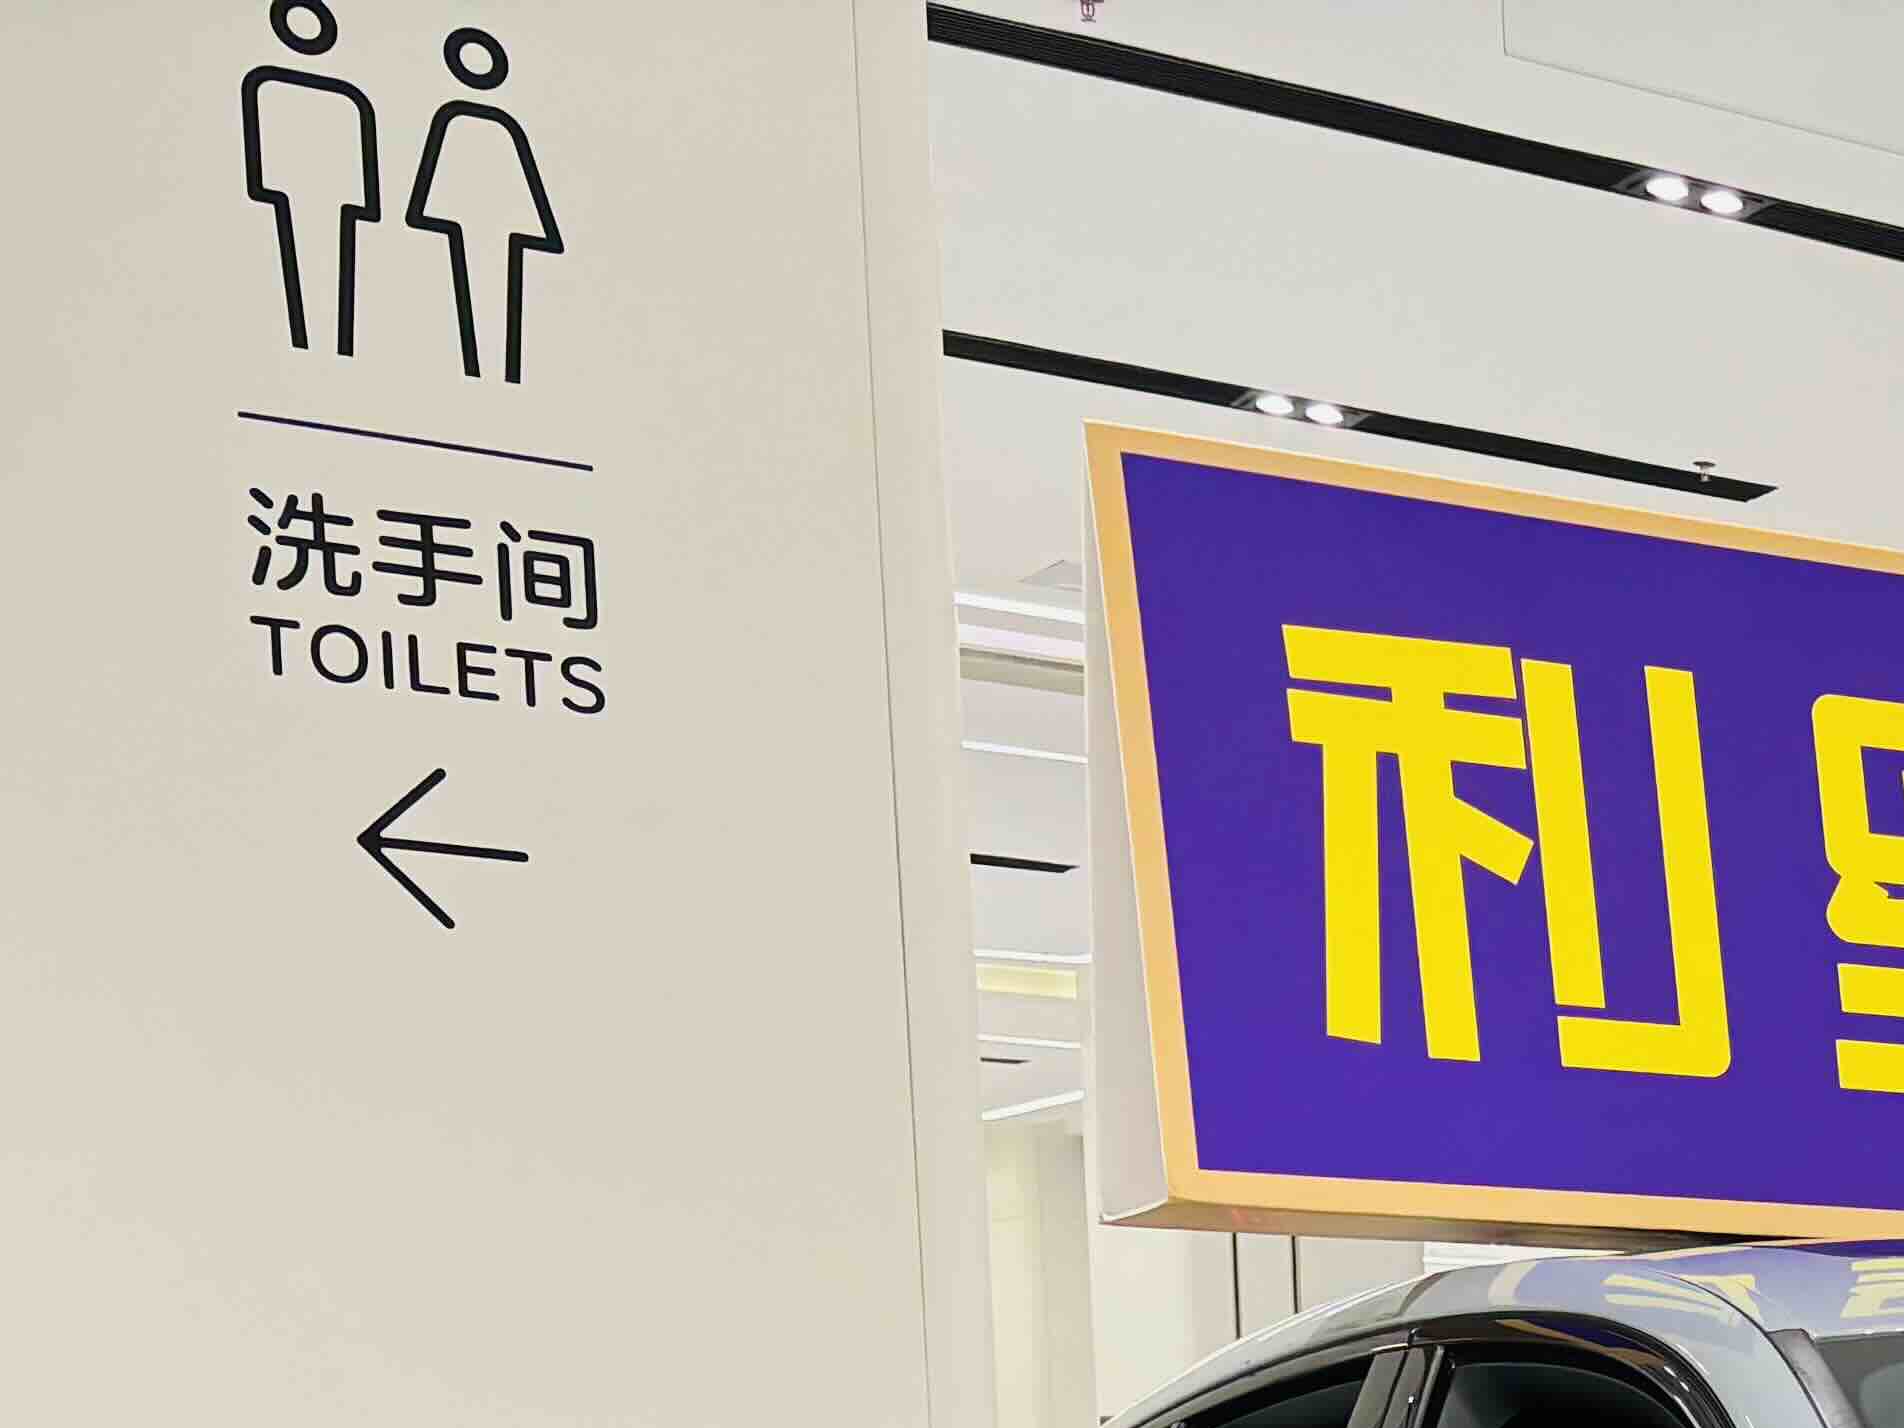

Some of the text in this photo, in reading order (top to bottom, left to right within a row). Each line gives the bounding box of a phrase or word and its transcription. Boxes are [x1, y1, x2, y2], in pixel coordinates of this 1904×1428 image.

[247, 486, 600, 630] 洗手间
[249, 614, 607, 715] TOILETS
